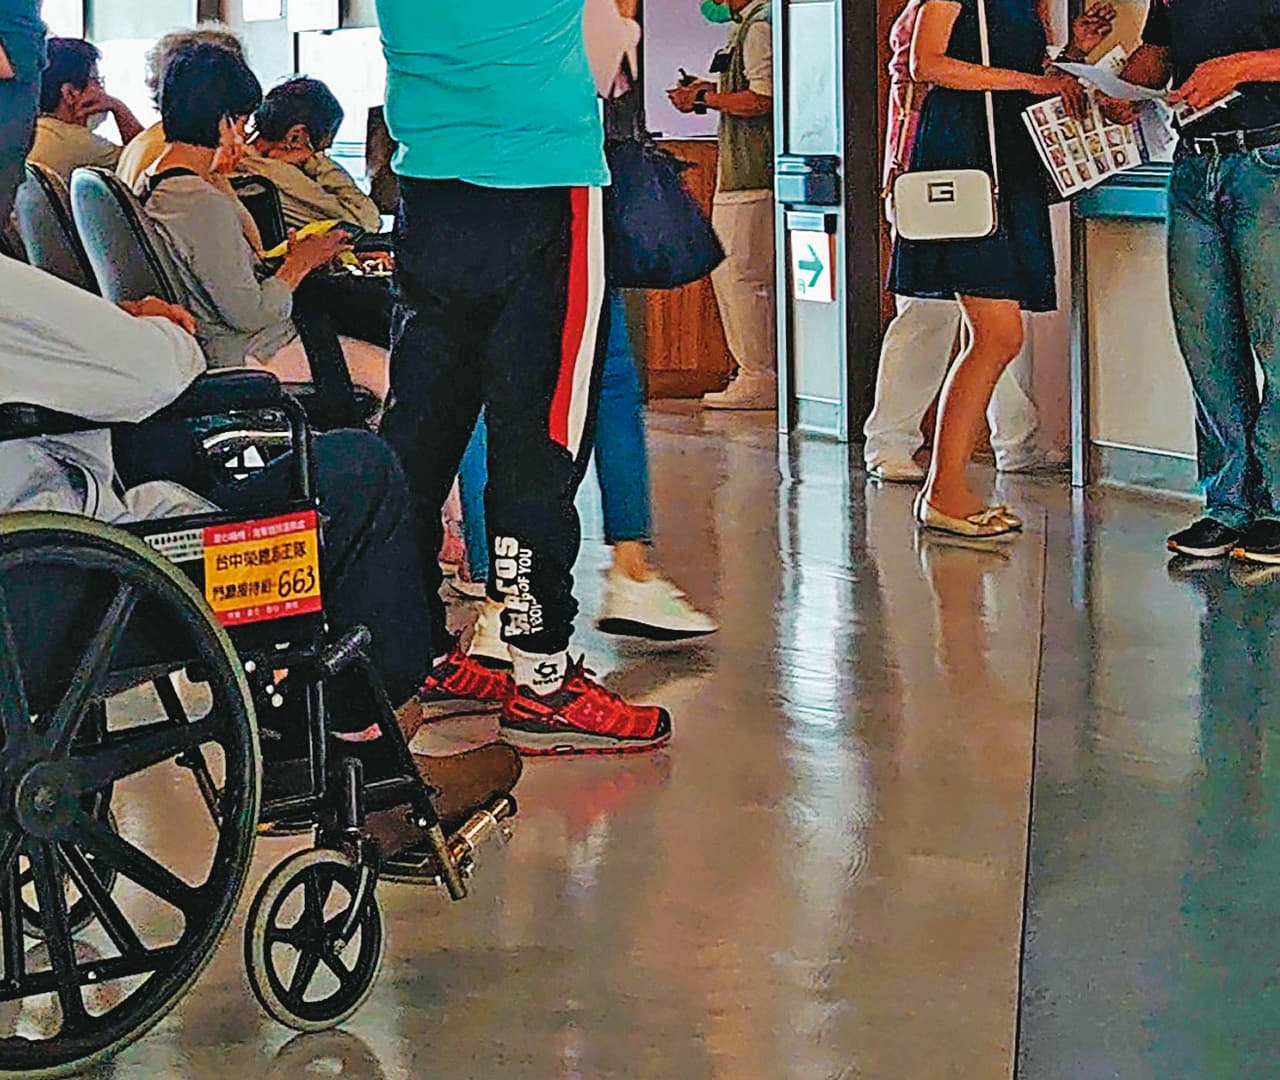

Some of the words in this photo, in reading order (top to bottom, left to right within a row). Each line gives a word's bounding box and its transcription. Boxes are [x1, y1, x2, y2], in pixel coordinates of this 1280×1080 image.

[928, 181, 954, 202] G
[519, 548, 533, 574] YOU
[278, 565, 315, 597] 663
